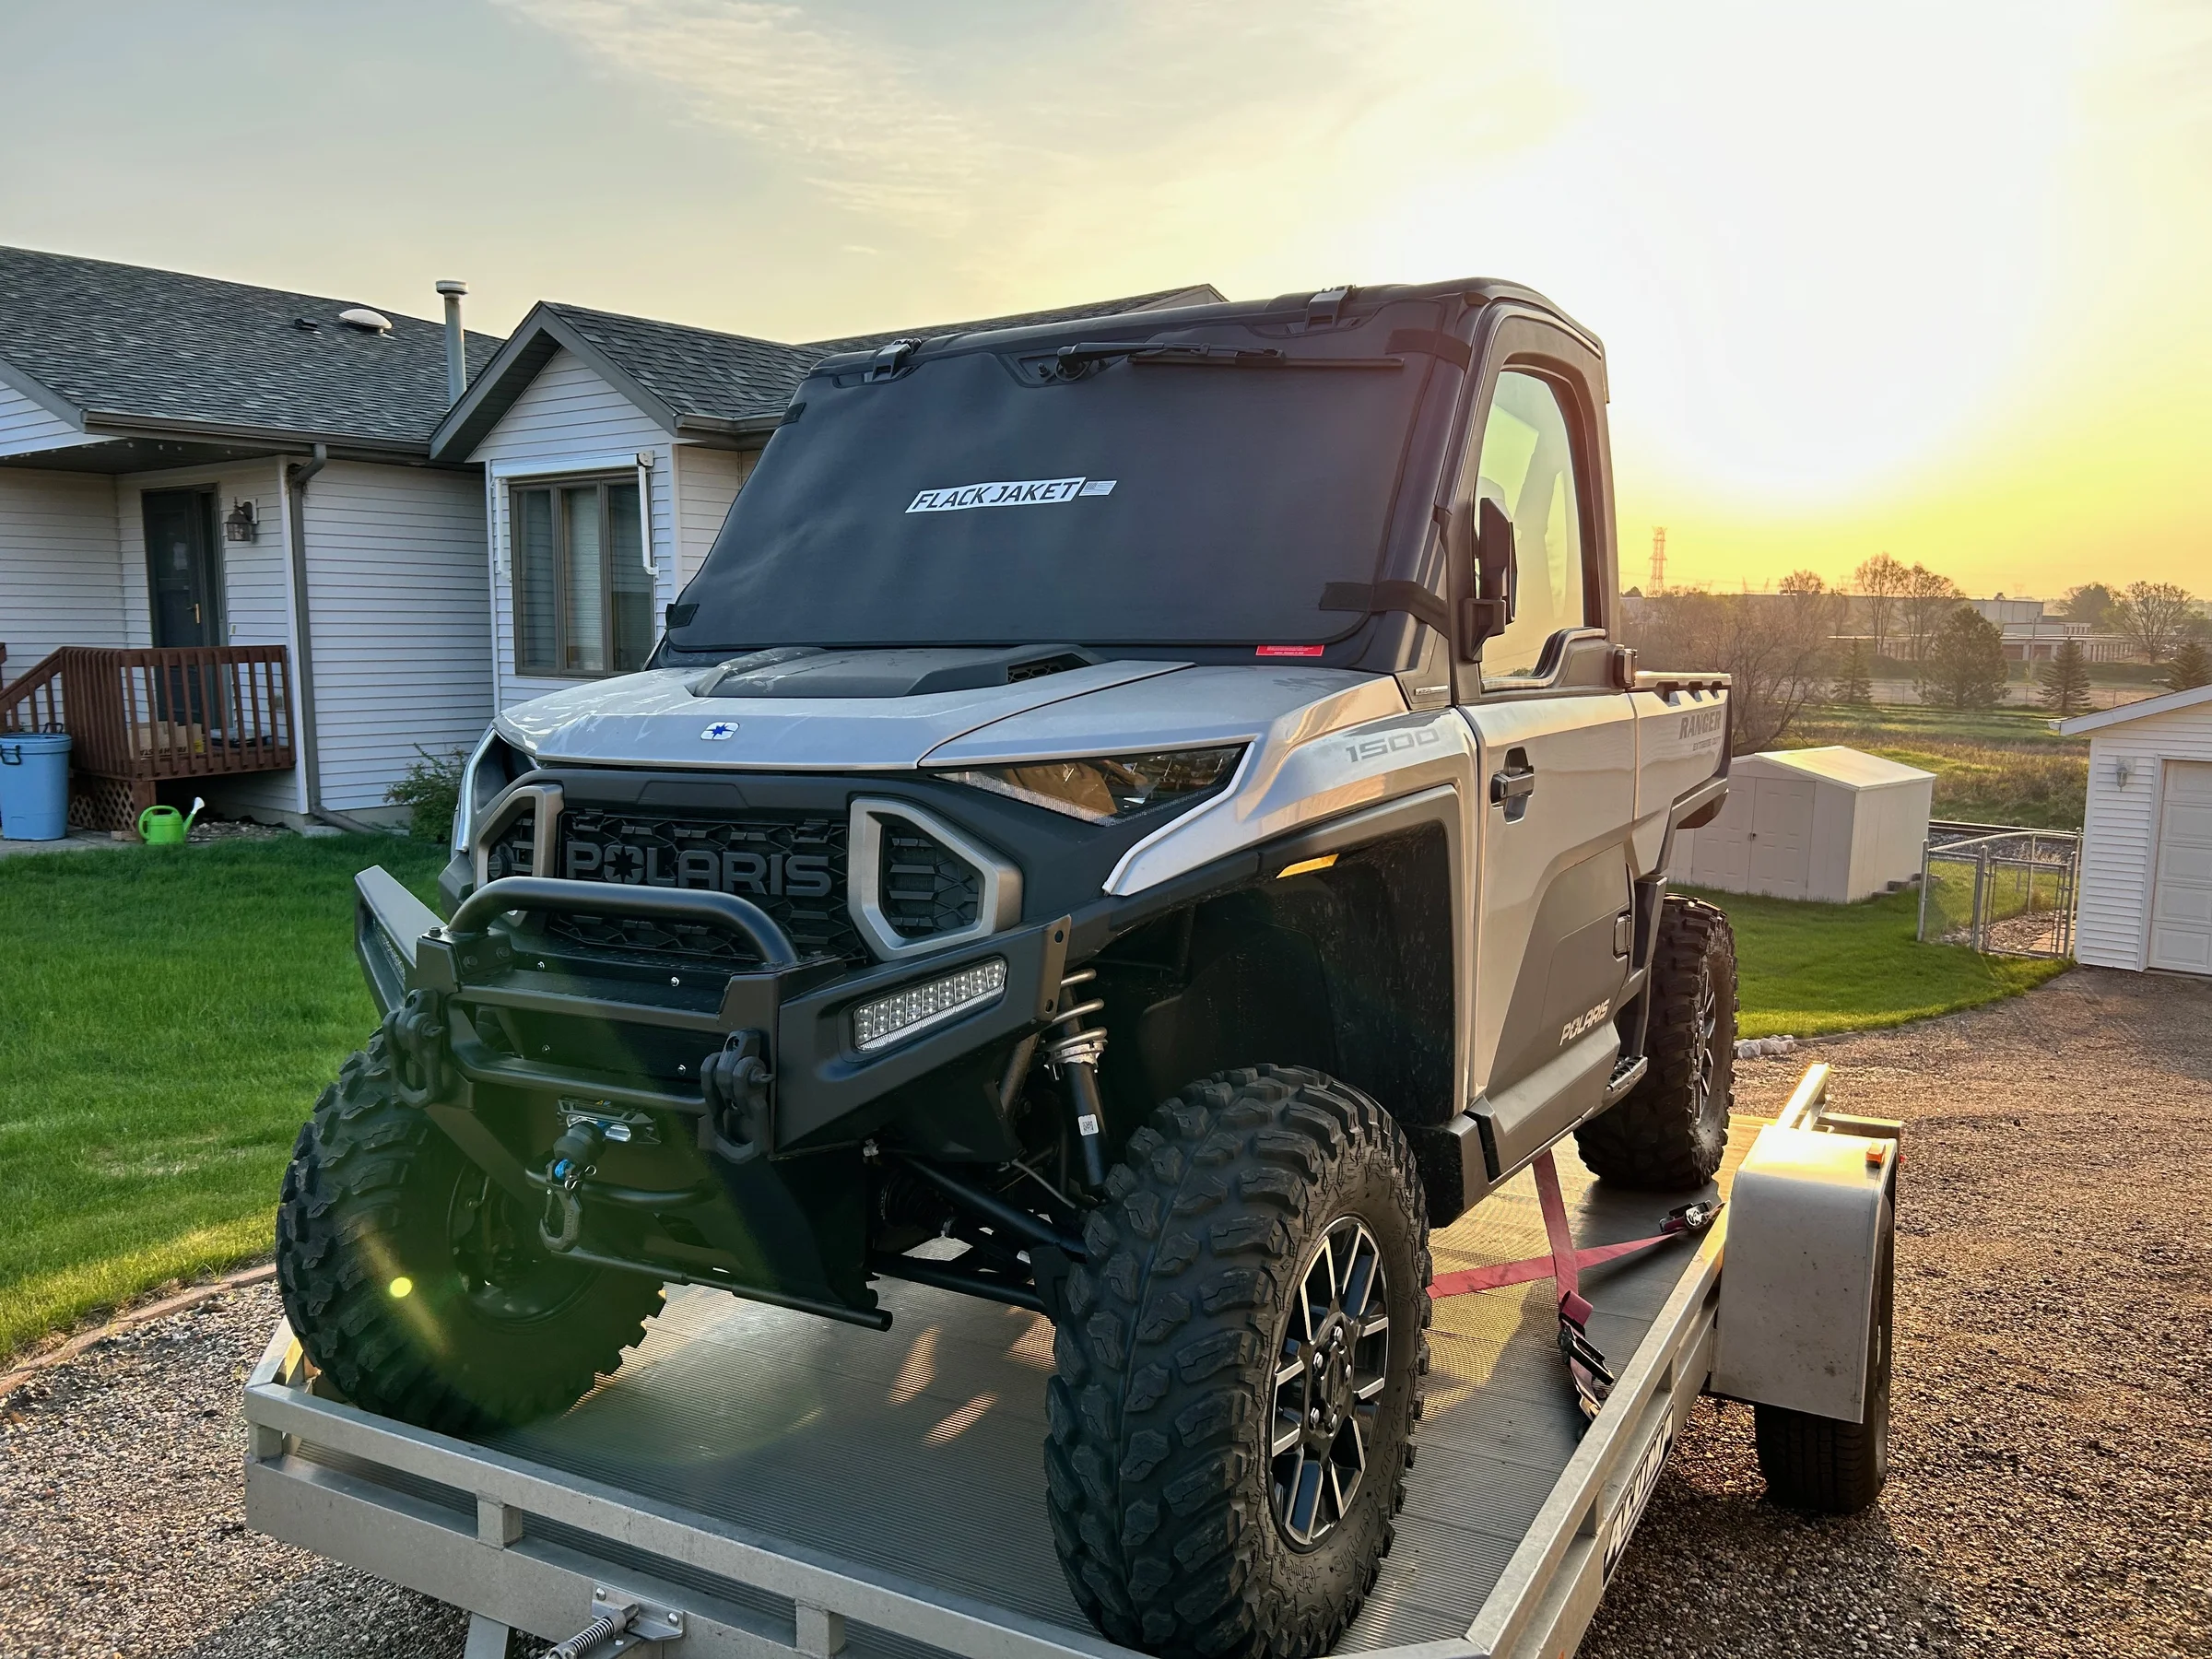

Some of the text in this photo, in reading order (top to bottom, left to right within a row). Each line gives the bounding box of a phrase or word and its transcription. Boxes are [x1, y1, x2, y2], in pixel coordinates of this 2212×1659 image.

[912, 481, 1079, 510] FLACK JAKET
[1678, 711, 1721, 739] RANGER
[1346, 729, 1440, 762] 1500
[566, 841, 831, 898] POLARIS
[1559, 998, 1610, 1046] POLARIS
[1604, 1403, 1674, 1568] ALUMA
